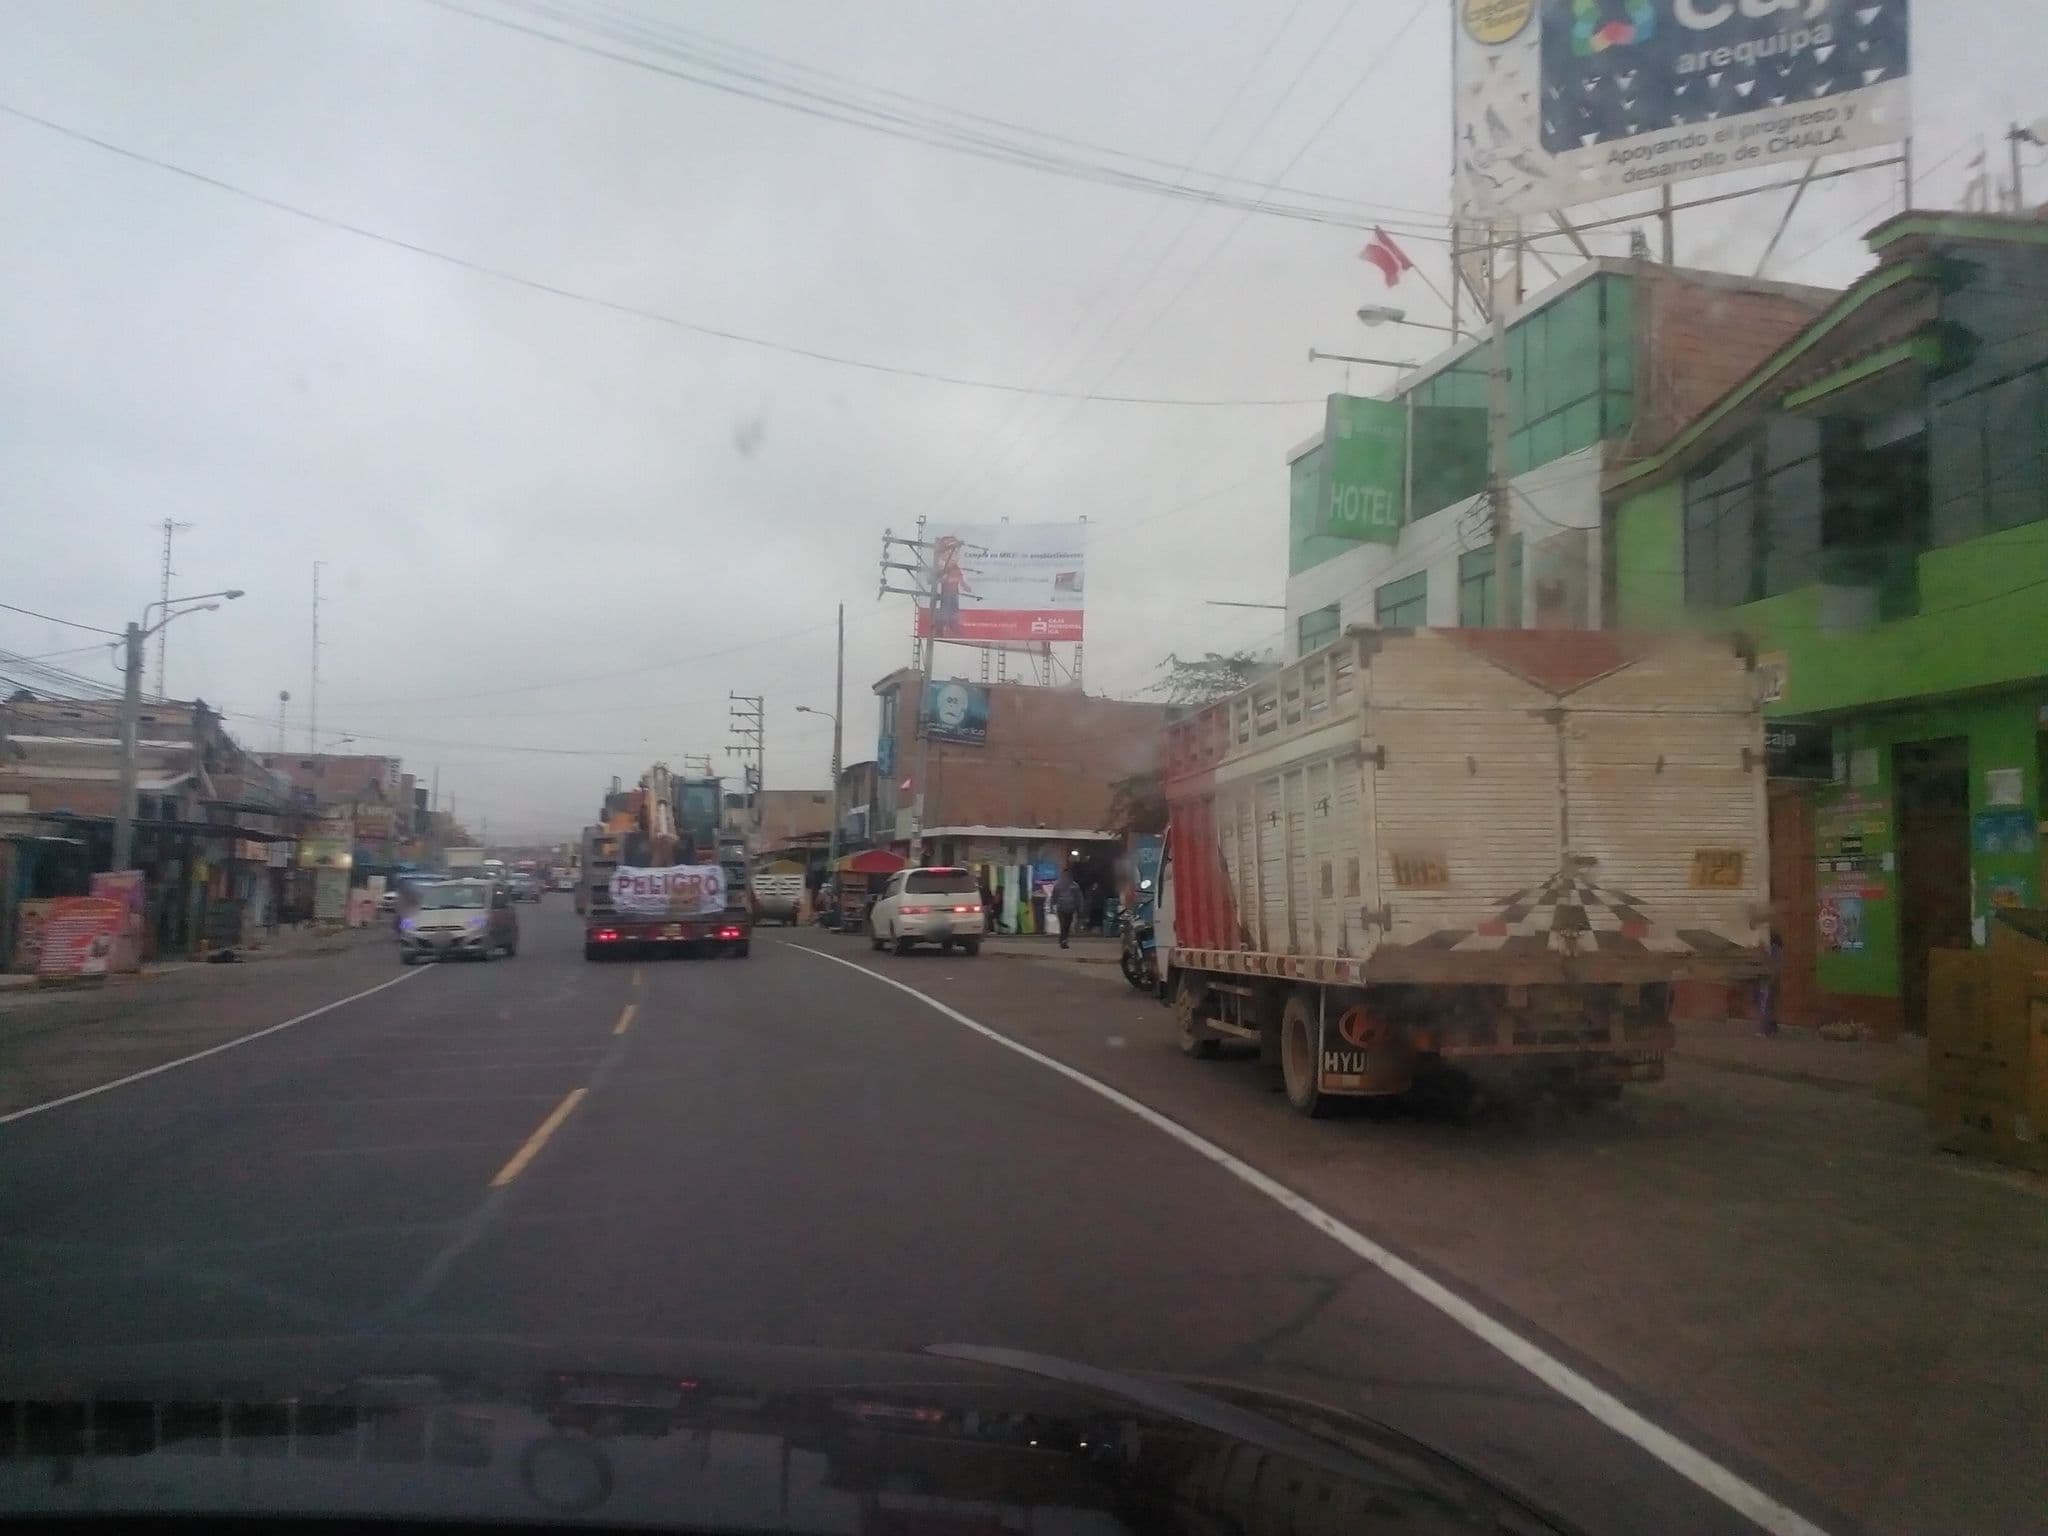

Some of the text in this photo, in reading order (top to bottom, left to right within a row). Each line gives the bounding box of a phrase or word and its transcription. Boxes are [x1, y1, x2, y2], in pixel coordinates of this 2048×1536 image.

[1675, 23, 1834, 75] arequipa
[1608, 131, 1709, 165] Apoyando
[1714, 126, 1733, 144] el
[1740, 107, 1838, 141] progreso
[1622, 126, 1846, 184] desarrollo de CHALA
[1329, 482, 1398, 526] HOTEL
[617, 873, 719, 897] PELIGRO
